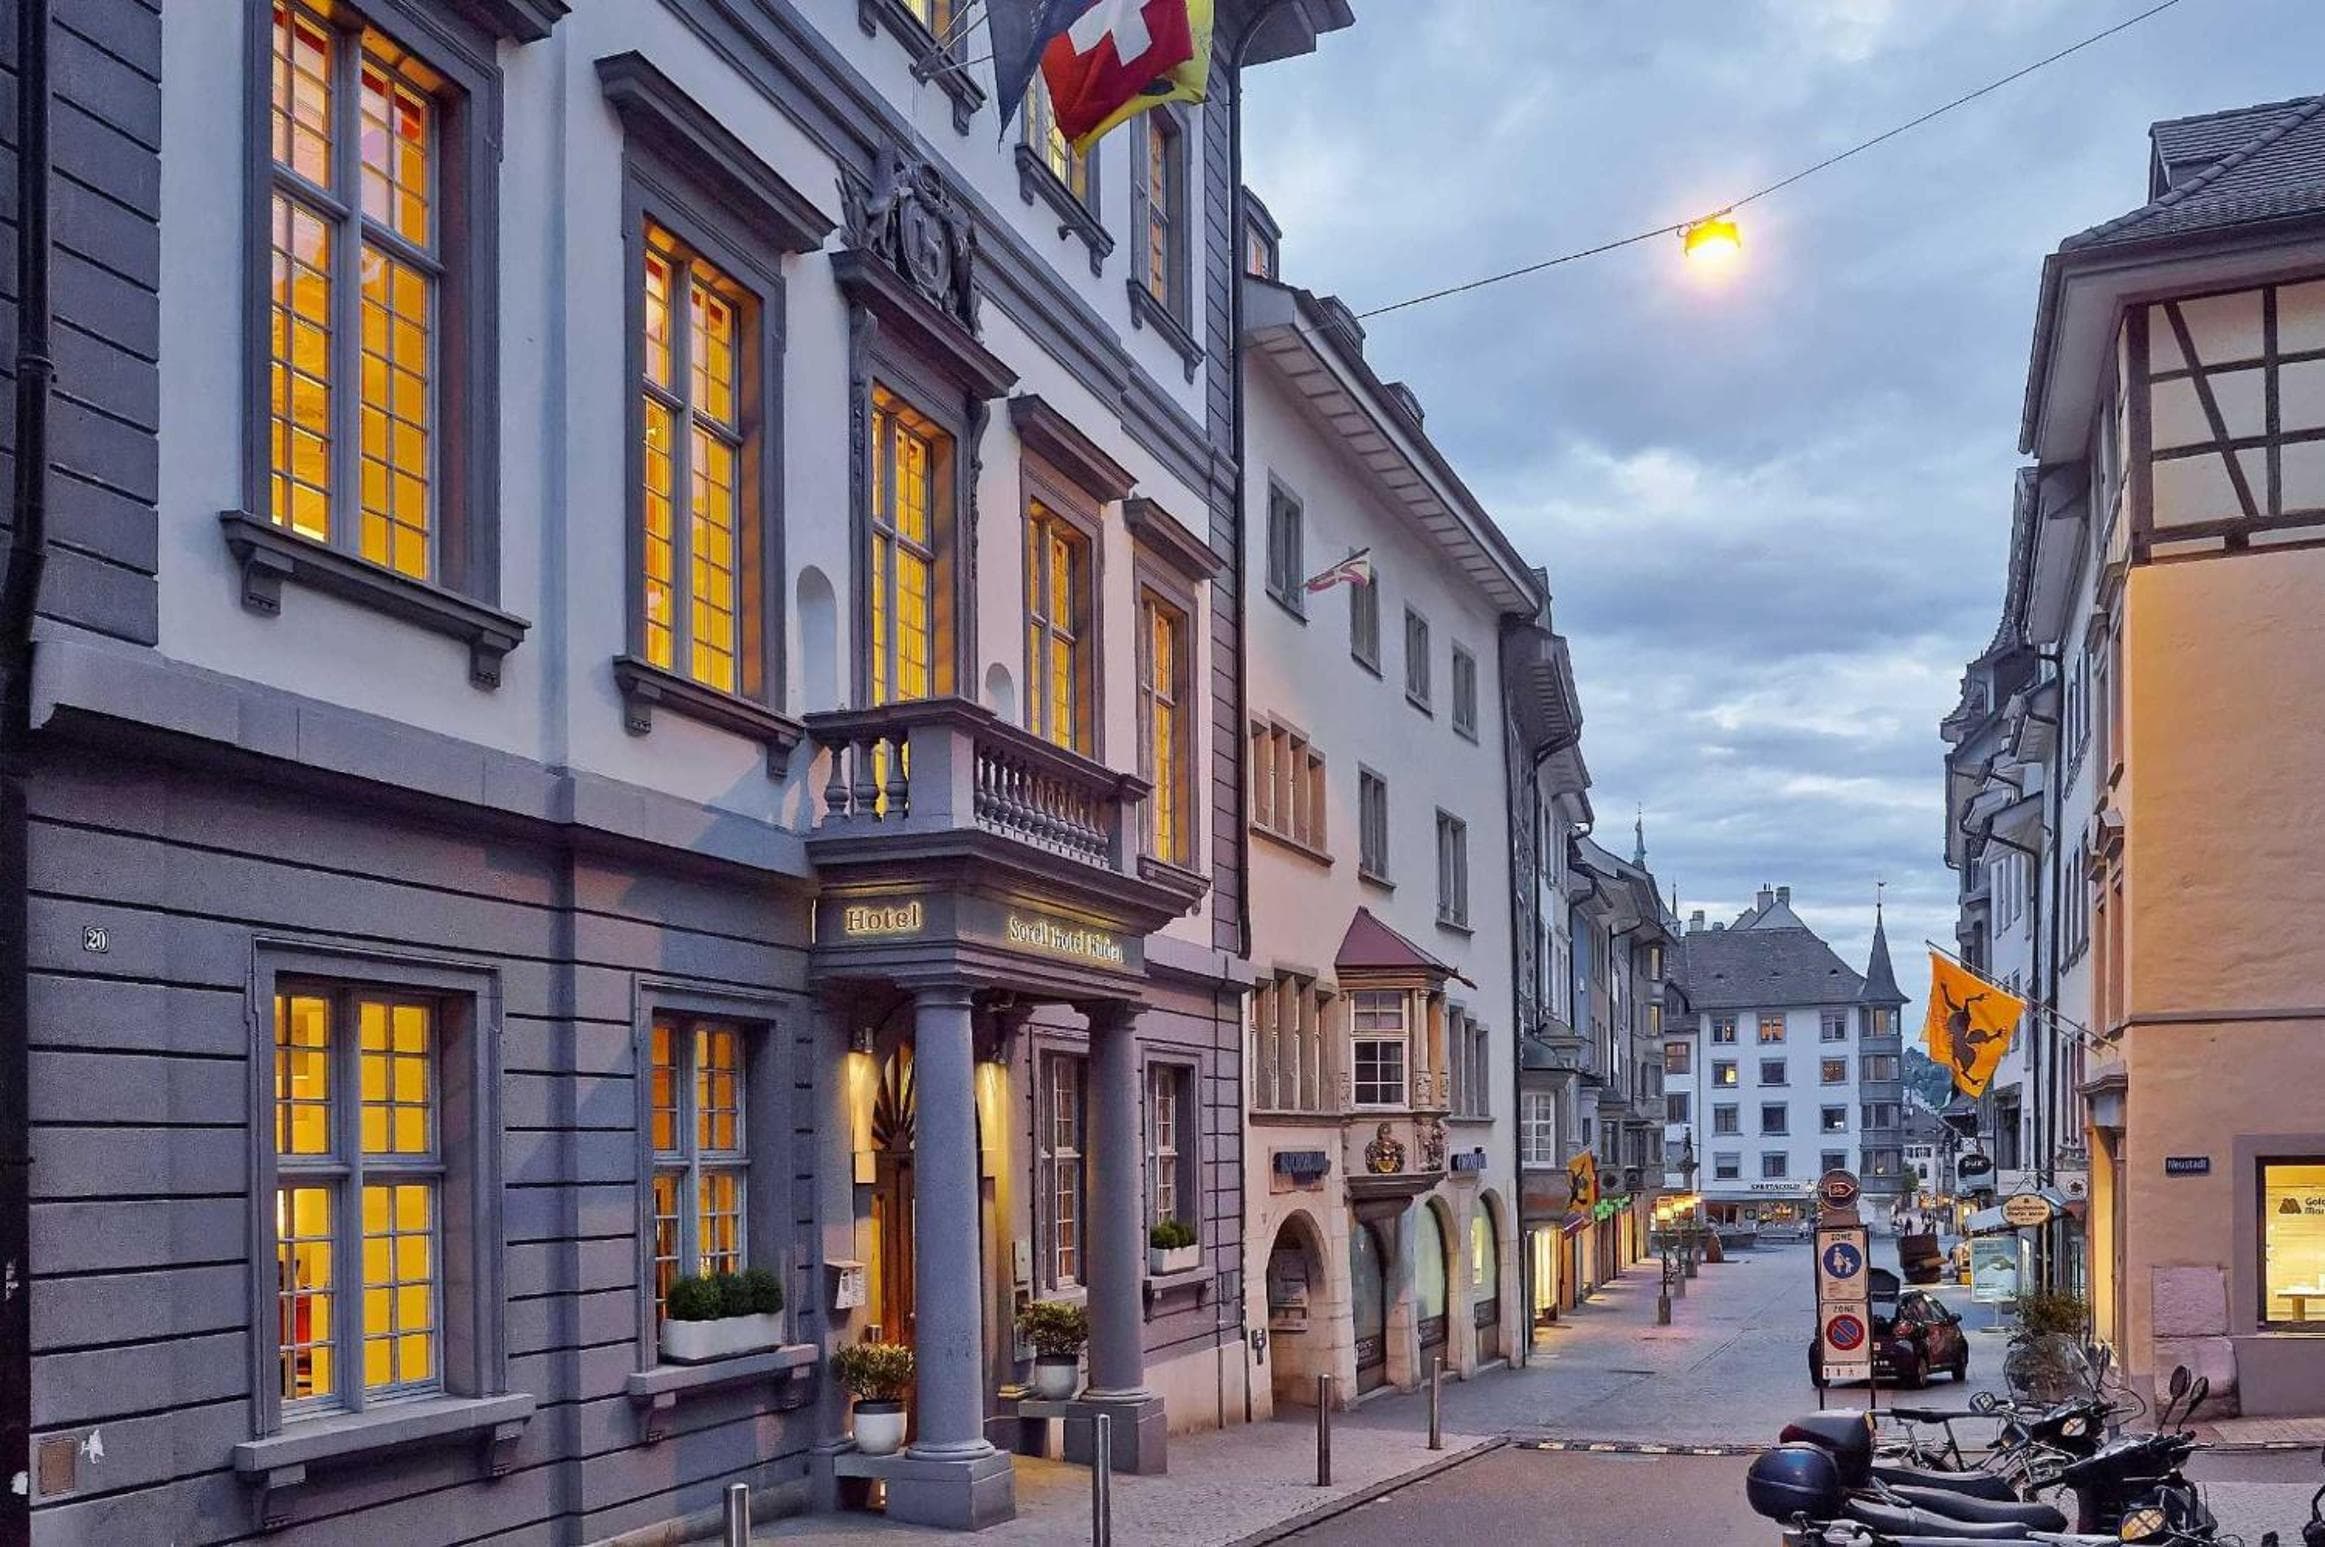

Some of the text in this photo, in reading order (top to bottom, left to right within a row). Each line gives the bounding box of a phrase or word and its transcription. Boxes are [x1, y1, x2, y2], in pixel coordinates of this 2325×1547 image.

[847, 904, 919, 931] Hotel
[87, 929, 106, 950] 20
[1008, 915, 1048, 945] Sorell
[1050, 926, 1085, 954] Hotel
[2168, 1159, 2207, 1169] Neustadt
[1831, 1233, 1853, 1241] ZONE
[1833, 1305, 1856, 1313] ZONE
